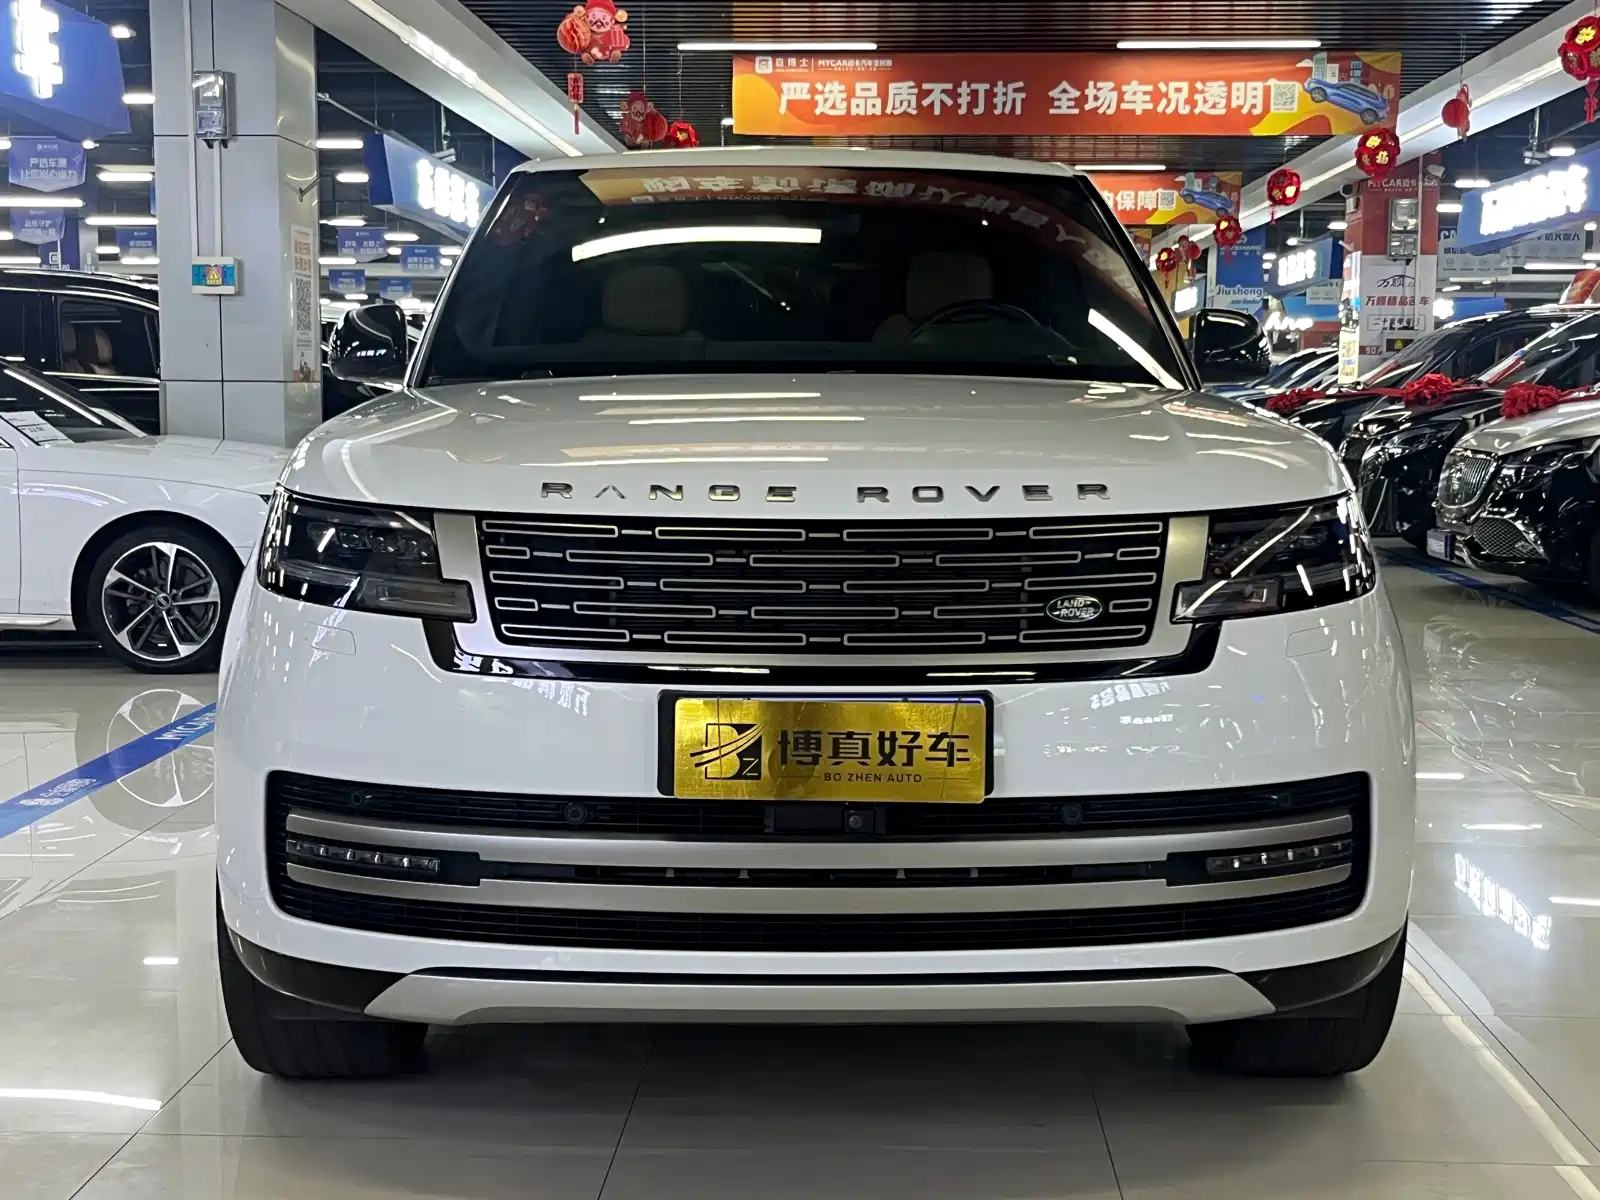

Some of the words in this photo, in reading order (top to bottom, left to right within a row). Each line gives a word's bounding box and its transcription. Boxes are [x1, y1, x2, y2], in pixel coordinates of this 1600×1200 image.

[779, 80, 1026, 116] 严选品质不打折
[1048, 80, 1265, 116] 全场车况透明
[540, 481, 797, 503] RANGE
[856, 483, 1111, 504] ROVER
[1057, 599, 1085, 609] LAND
[1059, 607, 1095, 618] ROVER
[777, 729, 972, 768] 博真好车
[824, 772, 842, 783] BO
[847, 773, 881, 783] ZHEN
[887, 773, 923, 783] AUTO
